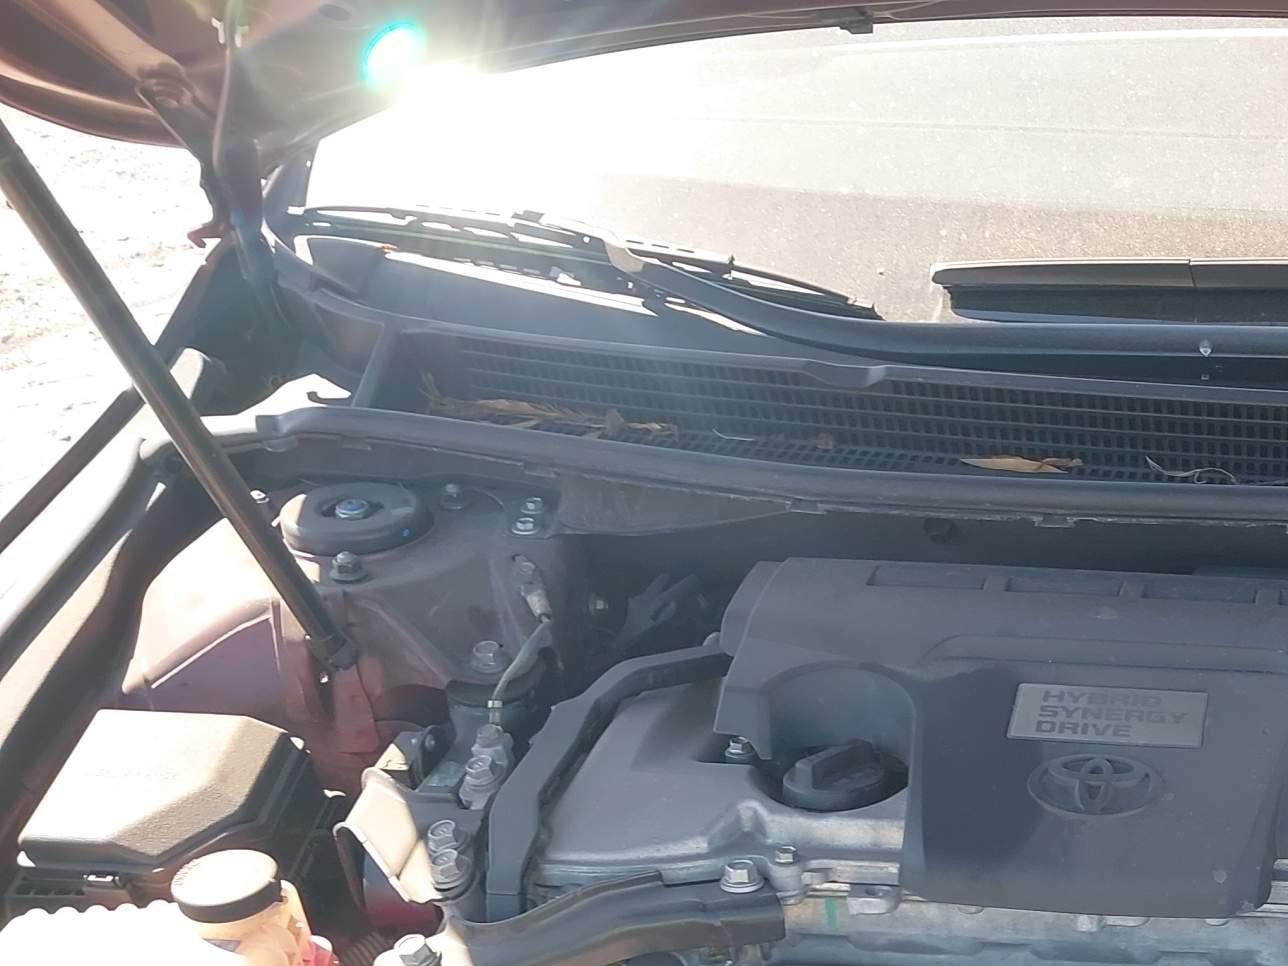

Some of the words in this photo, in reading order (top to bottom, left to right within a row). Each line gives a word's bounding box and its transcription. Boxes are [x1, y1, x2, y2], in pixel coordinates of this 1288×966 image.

[1041, 690, 1162, 707] HYBRID
[1037, 705, 1189, 724] SYNERGY
[1035, 720, 1132, 737] DRIVE
